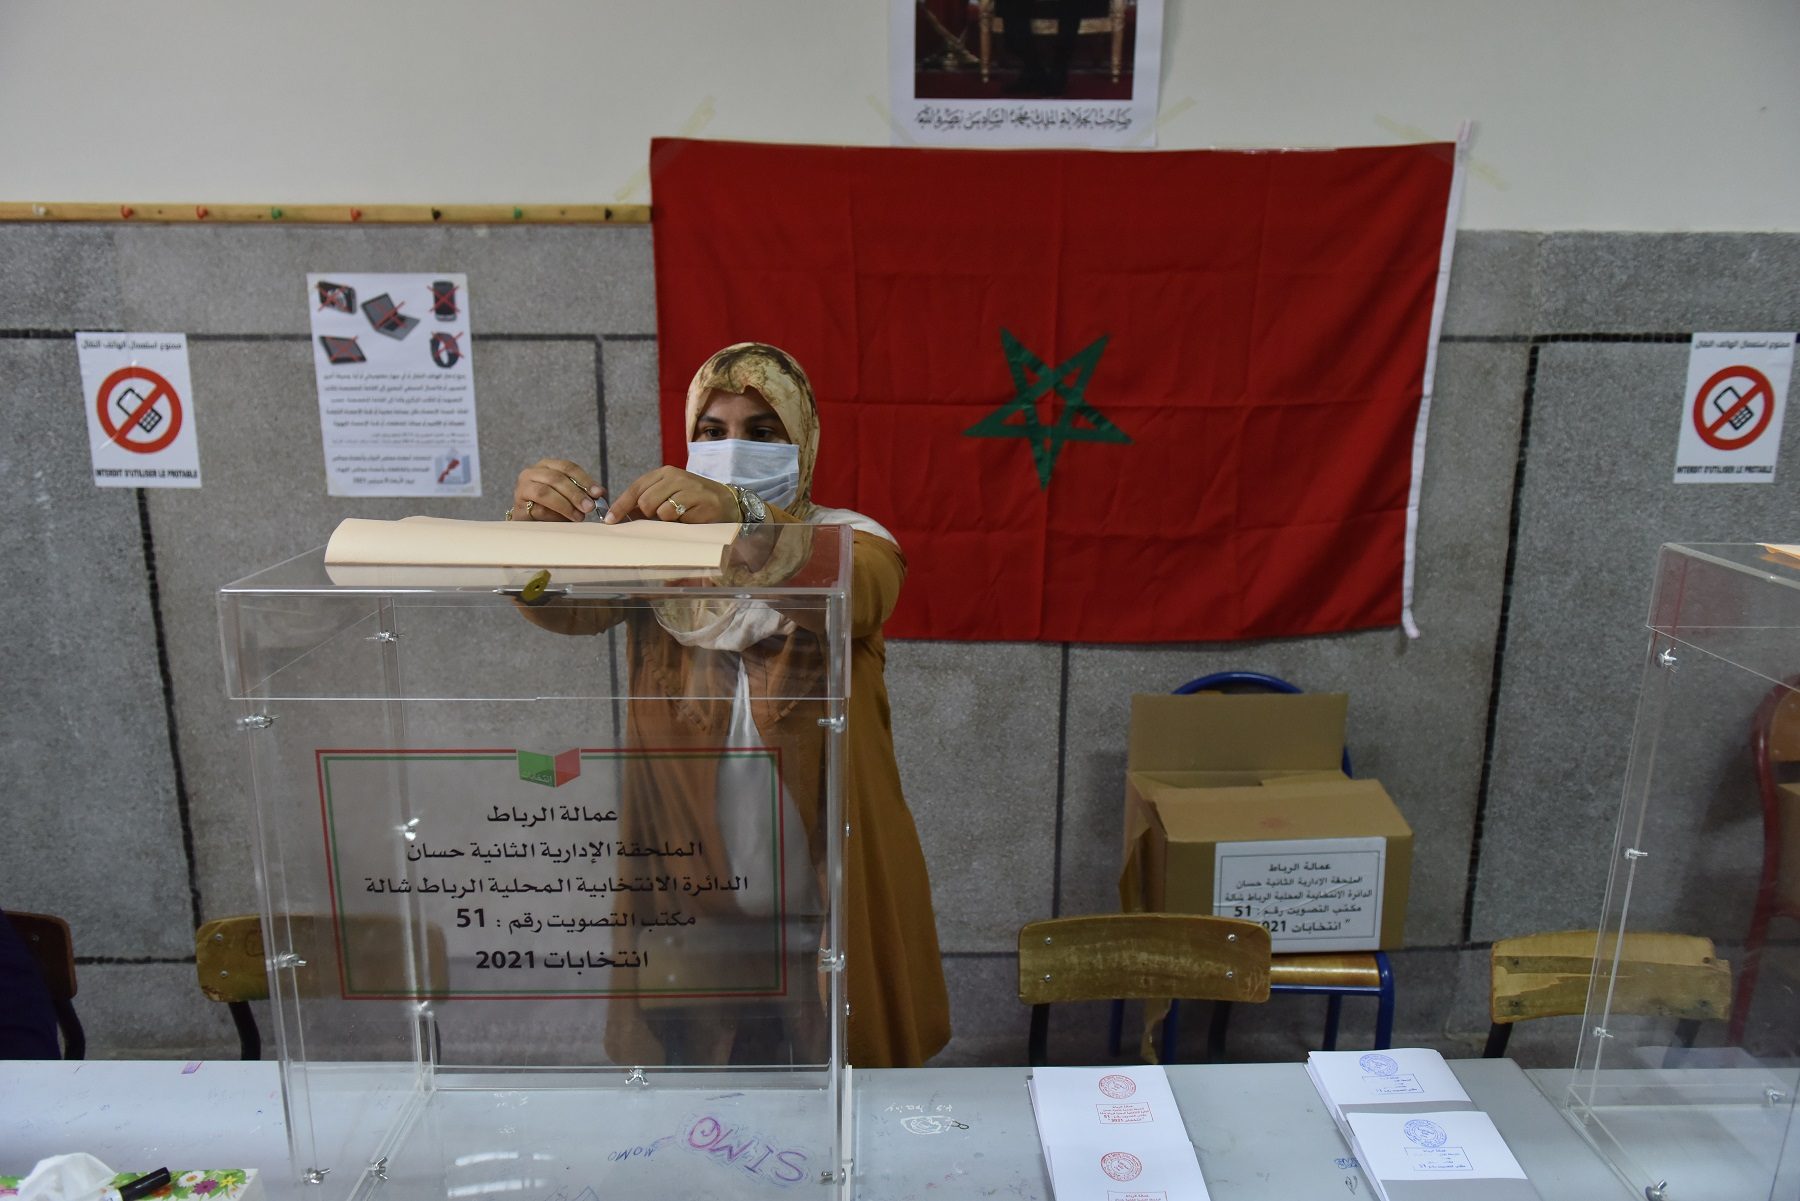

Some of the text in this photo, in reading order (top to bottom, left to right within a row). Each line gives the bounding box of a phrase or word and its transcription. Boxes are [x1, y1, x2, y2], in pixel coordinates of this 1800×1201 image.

[487, 805, 618, 827] عمالة الرباط
[407, 841, 702, 863] الملحقة الإدارية الثانية حسان
[1269, 861, 1331, 874] عمالة الرباط
[1236, 880, 1262, 889] حسان
[1266, 878, 1294, 888] الثانية
[1331, 876, 1362, 884] الملحقة
[365, 876, 748, 899] الدائرة الانتخابية المحلية الرباط شالة
[1234, 905, 1251, 917] 51
[1264, 906, 1283, 917] رقم
[1287, 905, 1329, 916] التصويت
[1333, 904, 1361, 916] مكتب
[456, 908, 485, 928] 51
[508, 913, 542, 935] رقم
[546, 912, 635, 933] التصويت
[641, 912, 696, 932] مكتب
[1257, 920, 1286, 932] 021
[1291, 922, 1341, 934] انتخابات
[476, 951, 648, 975] انتخابات 2021
